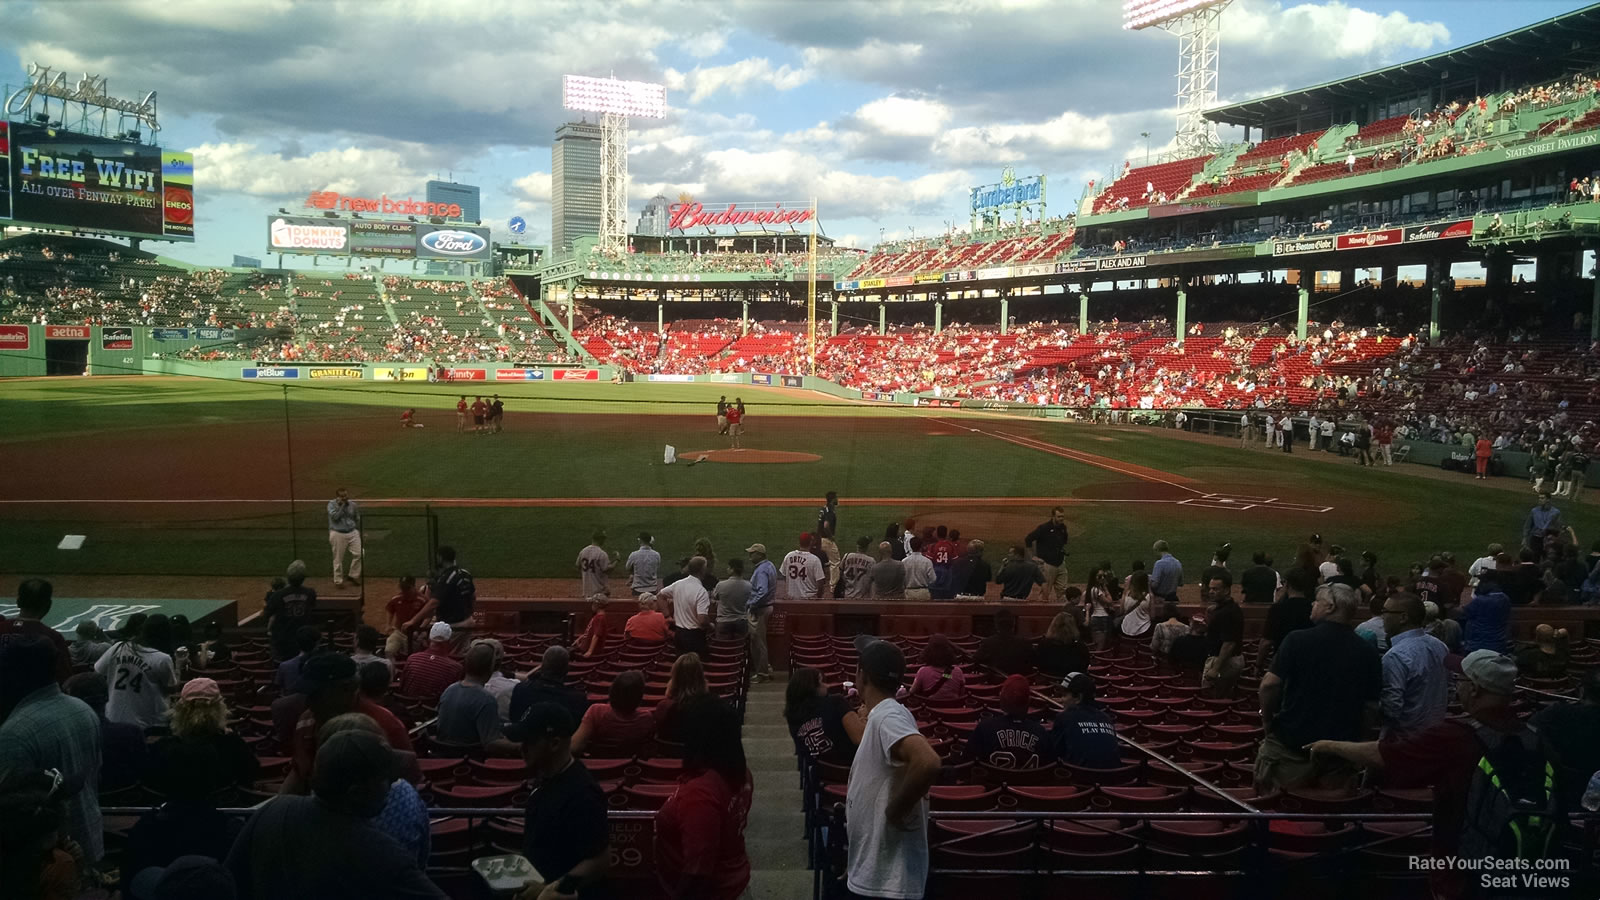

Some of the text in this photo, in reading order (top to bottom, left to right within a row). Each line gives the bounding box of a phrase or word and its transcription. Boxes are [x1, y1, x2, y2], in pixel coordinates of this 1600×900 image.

[1505, 134, 1597, 159] STATE STREET PAVILION
[20, 146, 85, 182] FREE
[20, 181, 44, 195] ALL
[47, 186, 75, 199] OVER
[78, 188, 123, 204] FENWAY
[126, 197, 156, 209] PARK!
[165, 201, 192, 210] ENEOS
[340, 196, 377, 212] new
[381, 194, 461, 217] balance
[668, 202, 815, 229] Budweiser
[293, 237, 342, 247] DONUTS
[1410, 231, 1440, 241] Safelite
[434, 233, 474, 252] Ford
[1285, 243, 1295, 252] The
[1315, 240, 1331, 249] Globe
[1101, 257, 1145, 269] ALEX AND ANI
[863, 280, 881, 288] STANLEY
[52, 327, 84, 337] aetna
[256, 368, 285, 378] jetBlue
[311, 369, 361, 378] GRANITE CITY
[387, 370, 415, 378] Non
[789, 556, 807, 566] ORTIZ
[937, 551, 948, 564] 34
[581, 557, 597, 573] 34
[788, 566, 808, 581] 34
[114, 668, 143, 693] 24
[804, 728, 833, 756] 15
[997, 729, 1040, 751] PRICE
[609, 823, 642, 832] IELD
